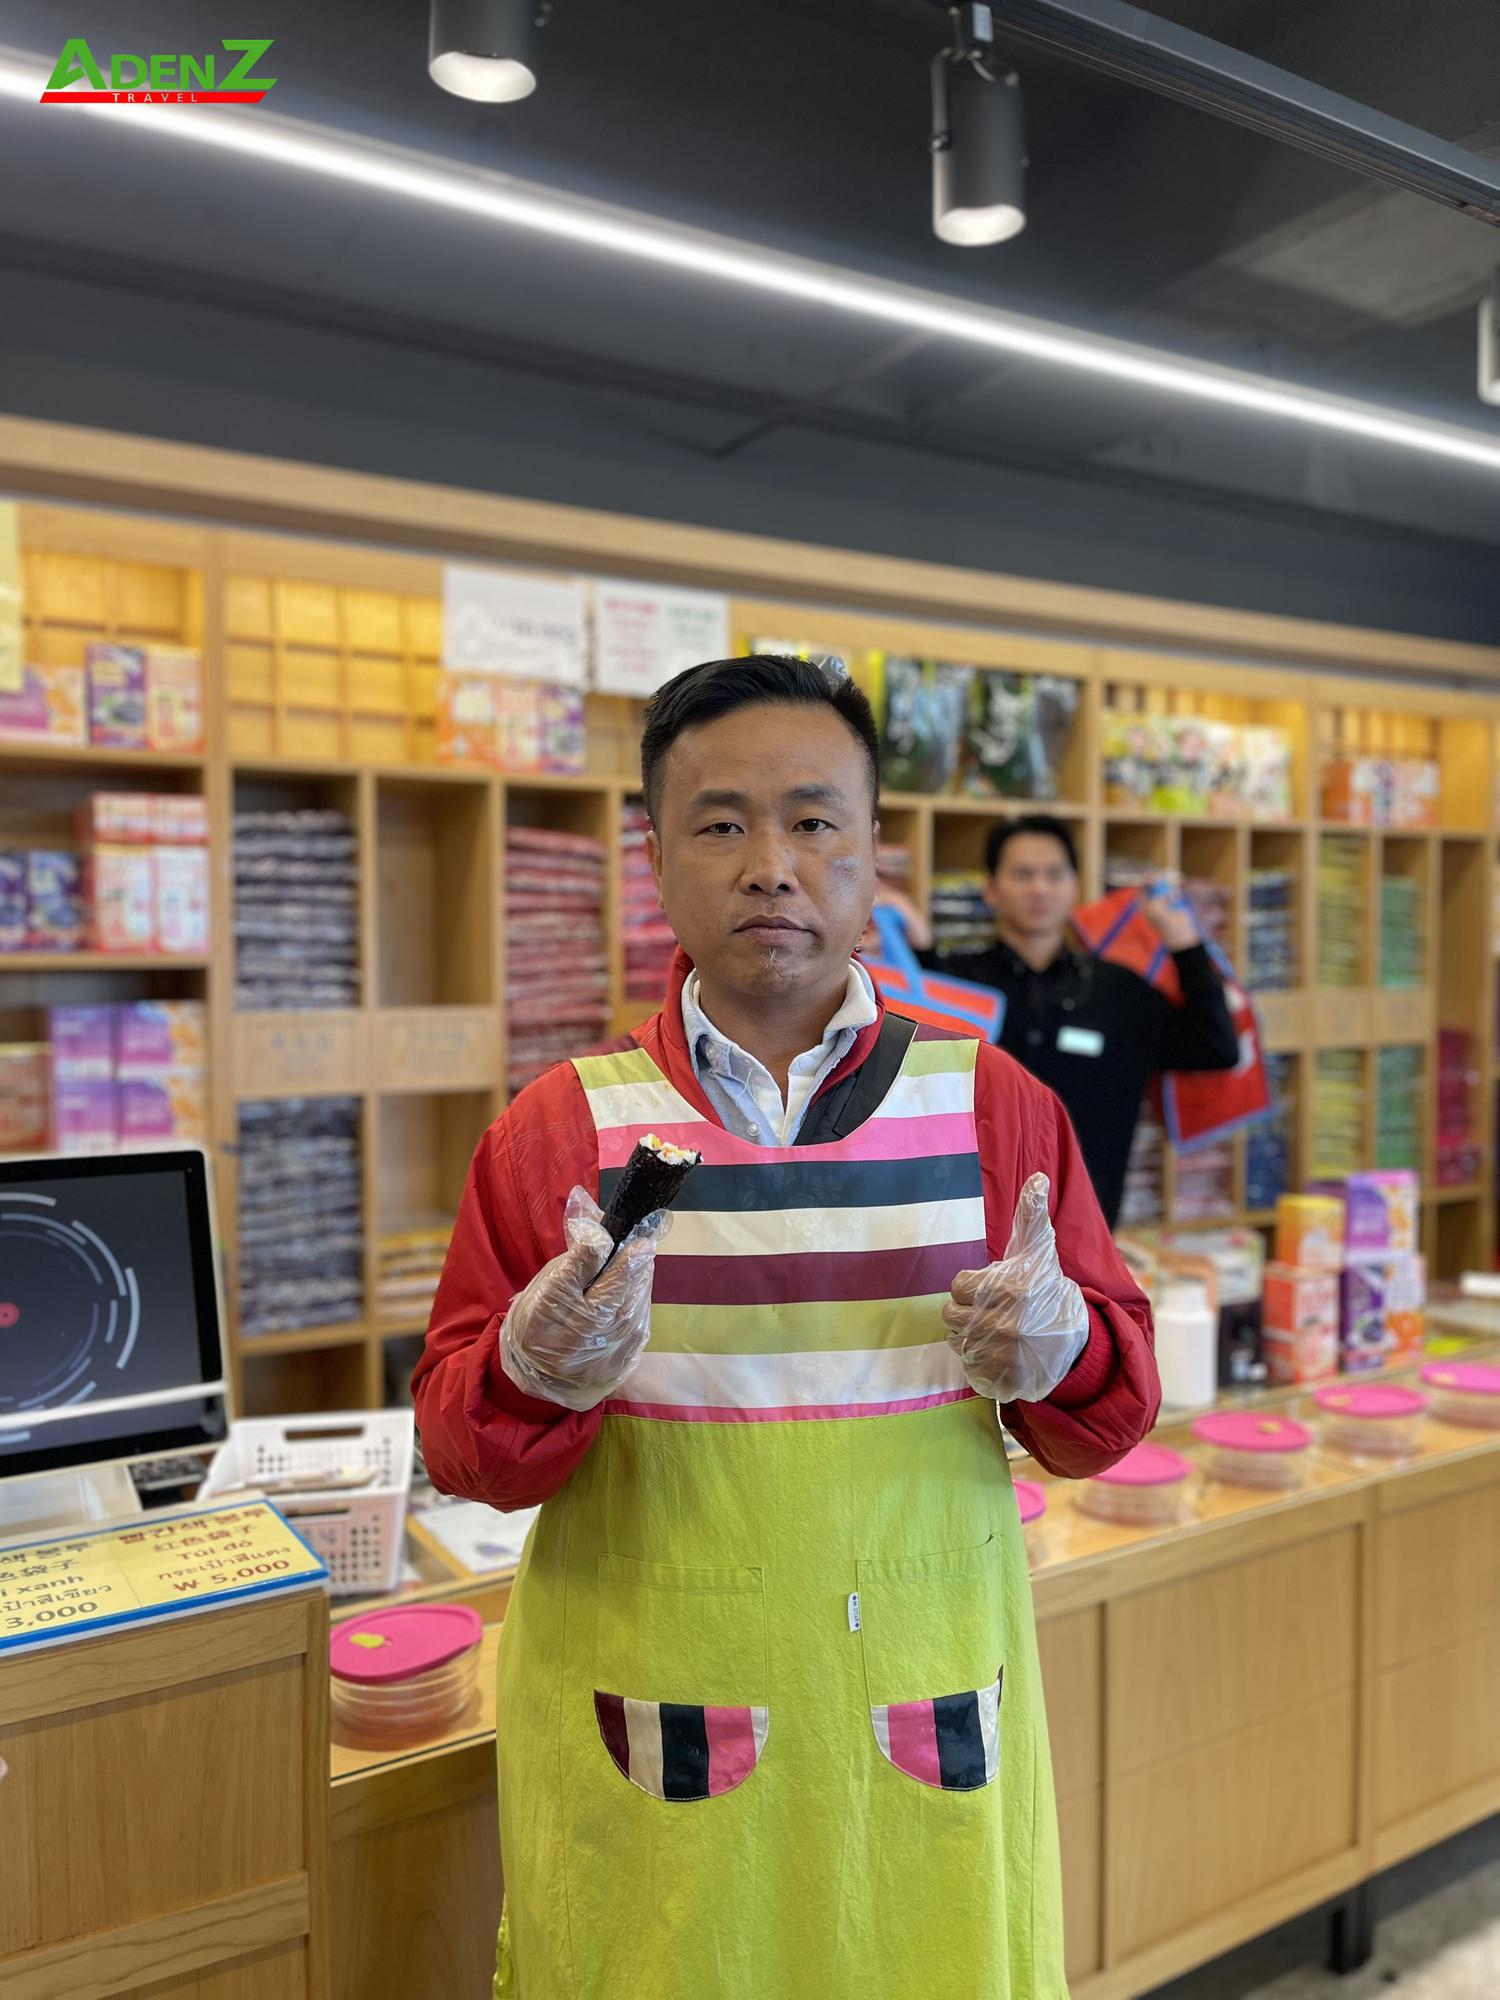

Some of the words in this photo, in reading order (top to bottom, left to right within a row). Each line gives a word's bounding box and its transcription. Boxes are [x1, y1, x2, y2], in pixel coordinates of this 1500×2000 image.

[16, 1575, 85, 1595] xanh
[210, 1559, 290, 1585] 5,000
[5, 1601, 98, 1630] 3,000
